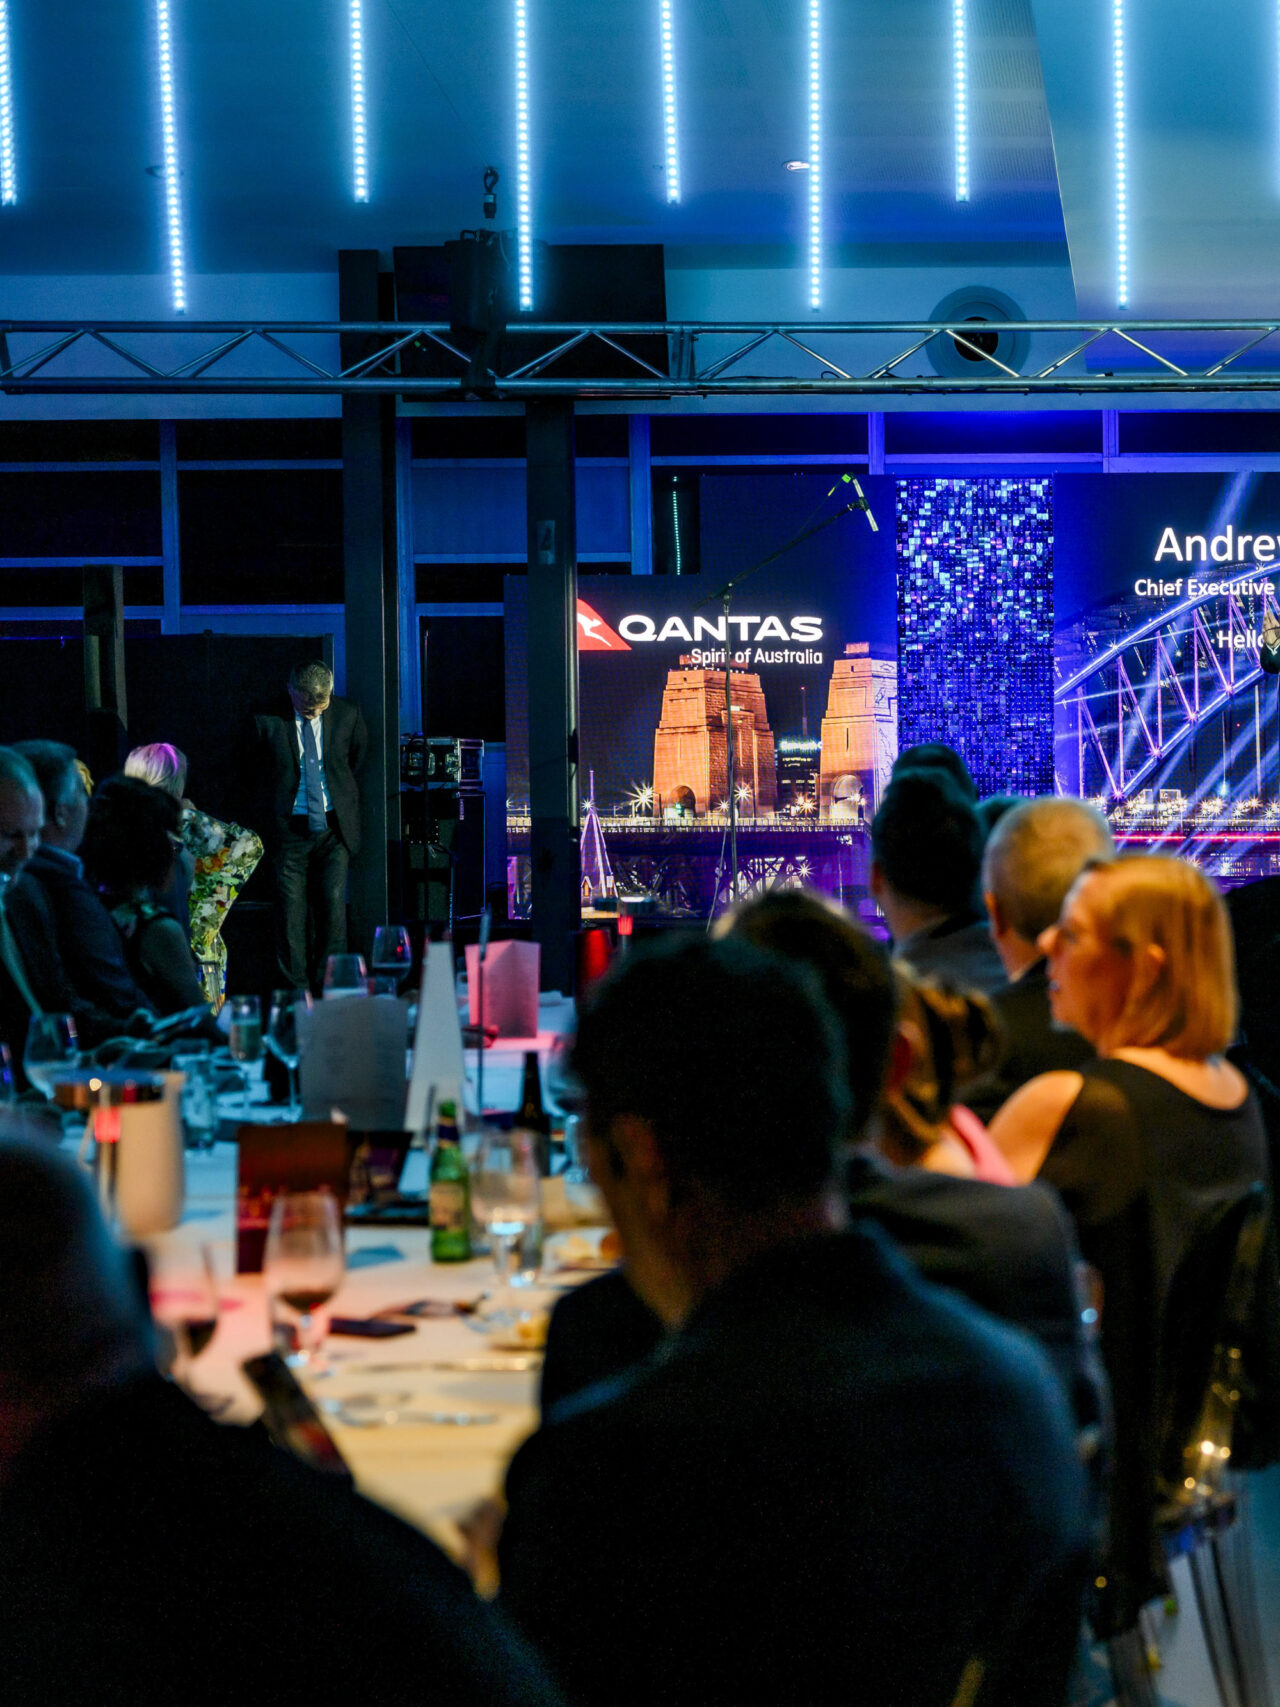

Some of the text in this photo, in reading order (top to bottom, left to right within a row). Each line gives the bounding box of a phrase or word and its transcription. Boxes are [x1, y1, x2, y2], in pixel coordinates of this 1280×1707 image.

[1134, 578, 1183, 596] Chief
[1187, 577, 1276, 597] Executive
[618, 614, 823, 642] QANTAS
[735, 647, 752, 664] of
[754, 647, 823, 665] Australia
